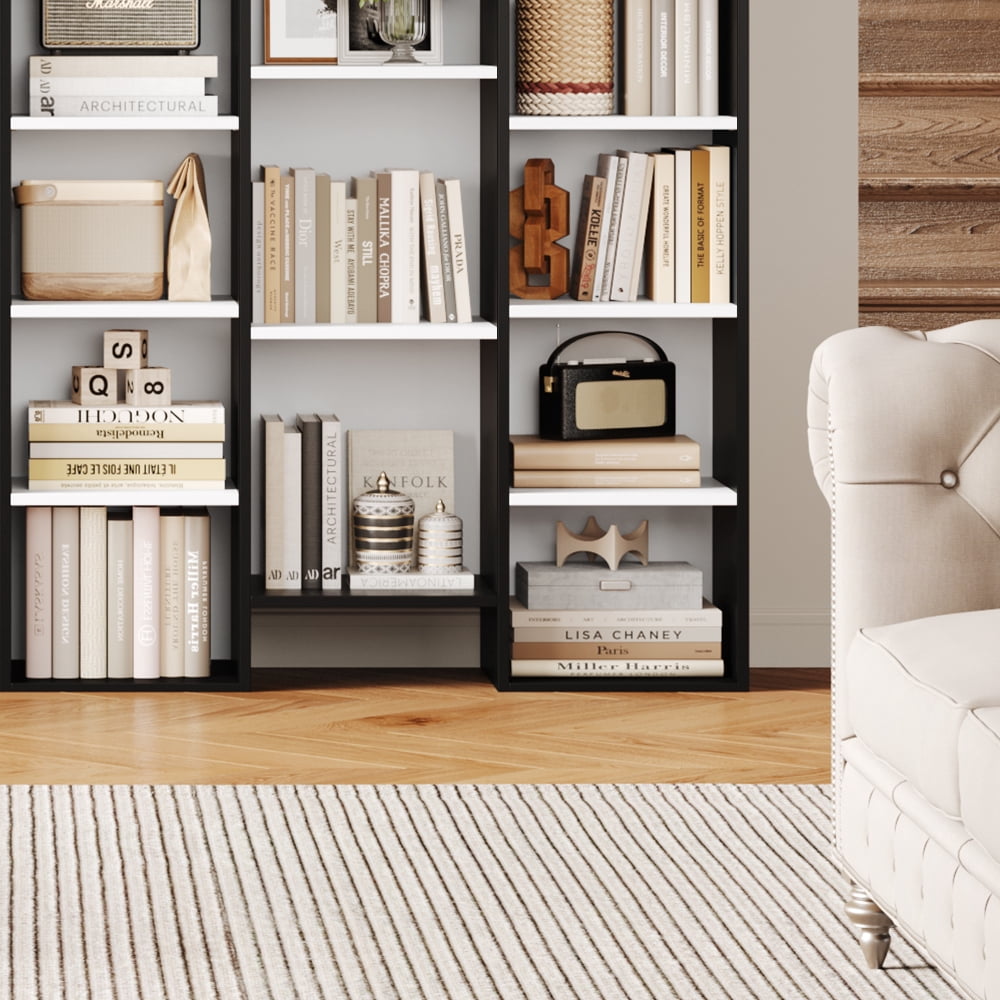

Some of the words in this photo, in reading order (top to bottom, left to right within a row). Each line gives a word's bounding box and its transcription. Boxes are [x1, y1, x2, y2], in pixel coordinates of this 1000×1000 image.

[40, 97, 54, 116] ar
[80, 101, 206, 111] ARCHITECTURAL
[379, 198, 389, 248] MALLIKA
[697, 216, 704, 227] OF
[299, 219, 312, 247] Dior
[362, 241, 373, 266] STILL
[454, 234, 464, 274] PRADA
[379, 252, 390, 298] CHOPRA
[112, 342, 133, 359] S
[89, 375, 108, 397] Q
[144, 381, 164, 395] 8
[78, 409, 184, 423] NOGUCHI
[96, 430, 164, 439] Remodelista
[67, 464, 88, 476] CAFÉ
[90, 464, 100, 475] LE
[103, 464, 121, 475] FOIS
[124, 464, 140, 475] UNE
[143, 464, 166, 476] ÉTAIT
[170, 464, 176, 474] IL
[327, 432, 337, 544] ARCHITECTURAL
[268, 569, 282, 580] AD
[305, 569, 319, 580] AD
[323, 567, 340, 580] ar
[361, 577, 462, 588] LATINOAMERICA
[565, 631, 603, 640] LISA
[613, 631, 683, 640] CHANEY
[597, 646, 629, 655] Paris
[557, 663, 619, 671] Miller
[626, 663, 690, 671] Harris
